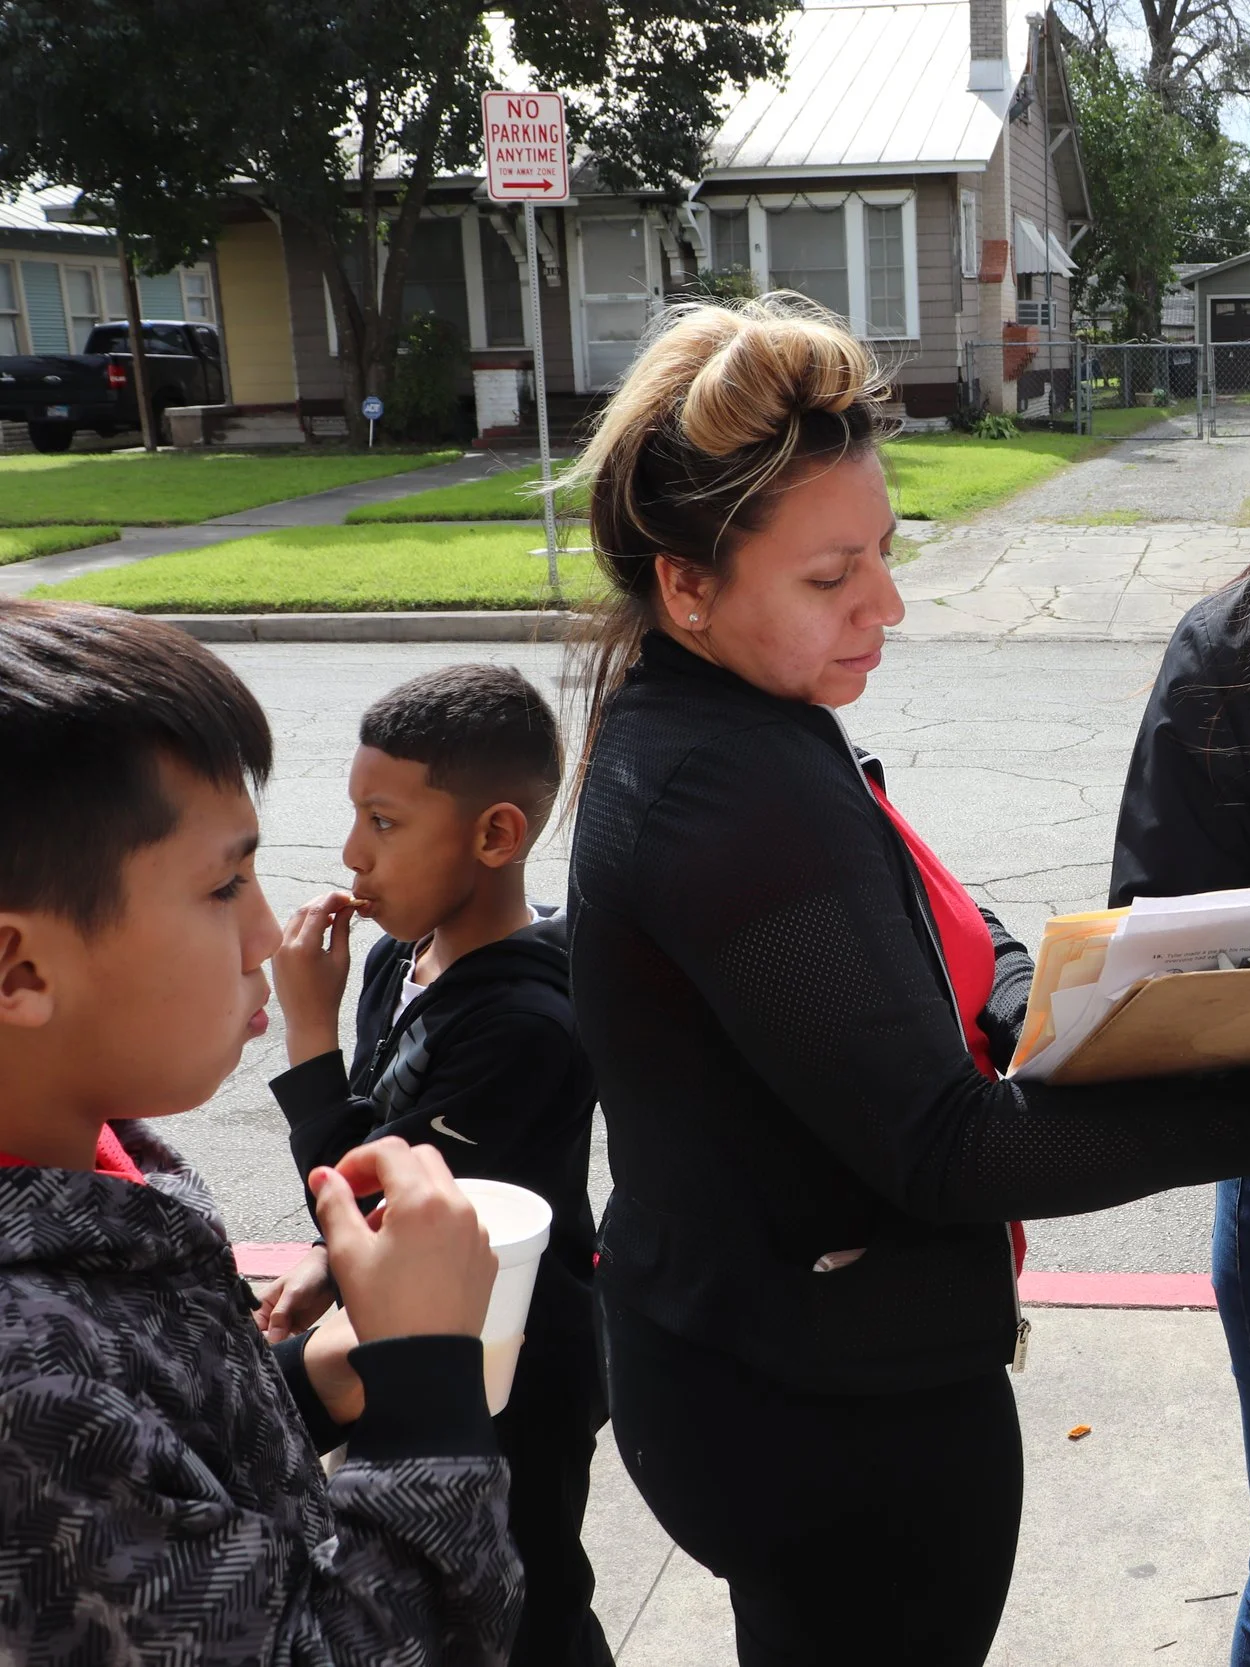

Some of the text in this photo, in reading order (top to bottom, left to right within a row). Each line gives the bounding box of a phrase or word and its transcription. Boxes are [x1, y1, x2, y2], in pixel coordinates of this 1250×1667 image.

[507, 99, 539, 119] NO
[491, 123, 559, 143] PARKING
[496, 147, 558, 163] ANYTIME
[499, 167, 556, 176] TOW AWAY ZONE
